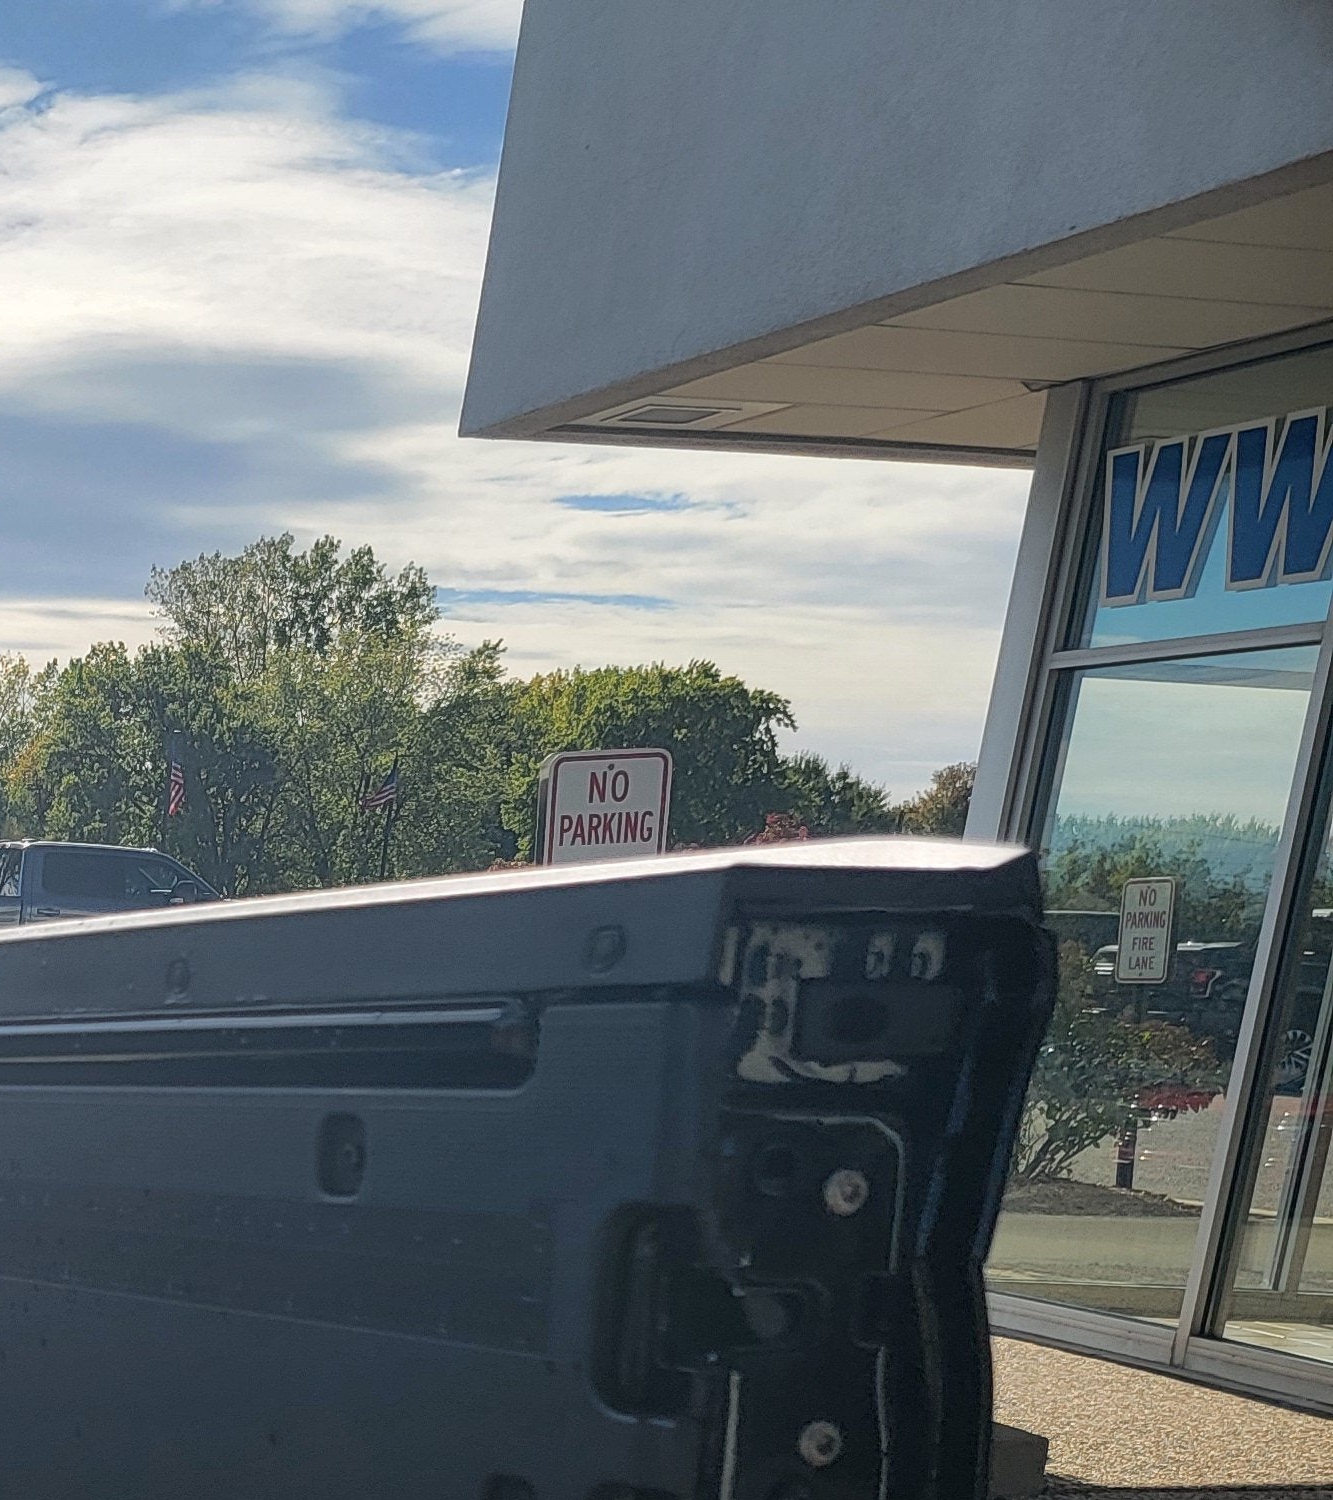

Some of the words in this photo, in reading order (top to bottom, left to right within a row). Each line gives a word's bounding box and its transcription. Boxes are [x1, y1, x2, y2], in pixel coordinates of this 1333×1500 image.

[588, 769, 629, 803] NO
[558, 810, 654, 846] PARKING
[1138, 888, 1157, 907] NO
[1124, 910, 1167, 930] PARKING
[1132, 936, 1156, 951] FIRE
[1128, 956, 1156, 970] LANE
